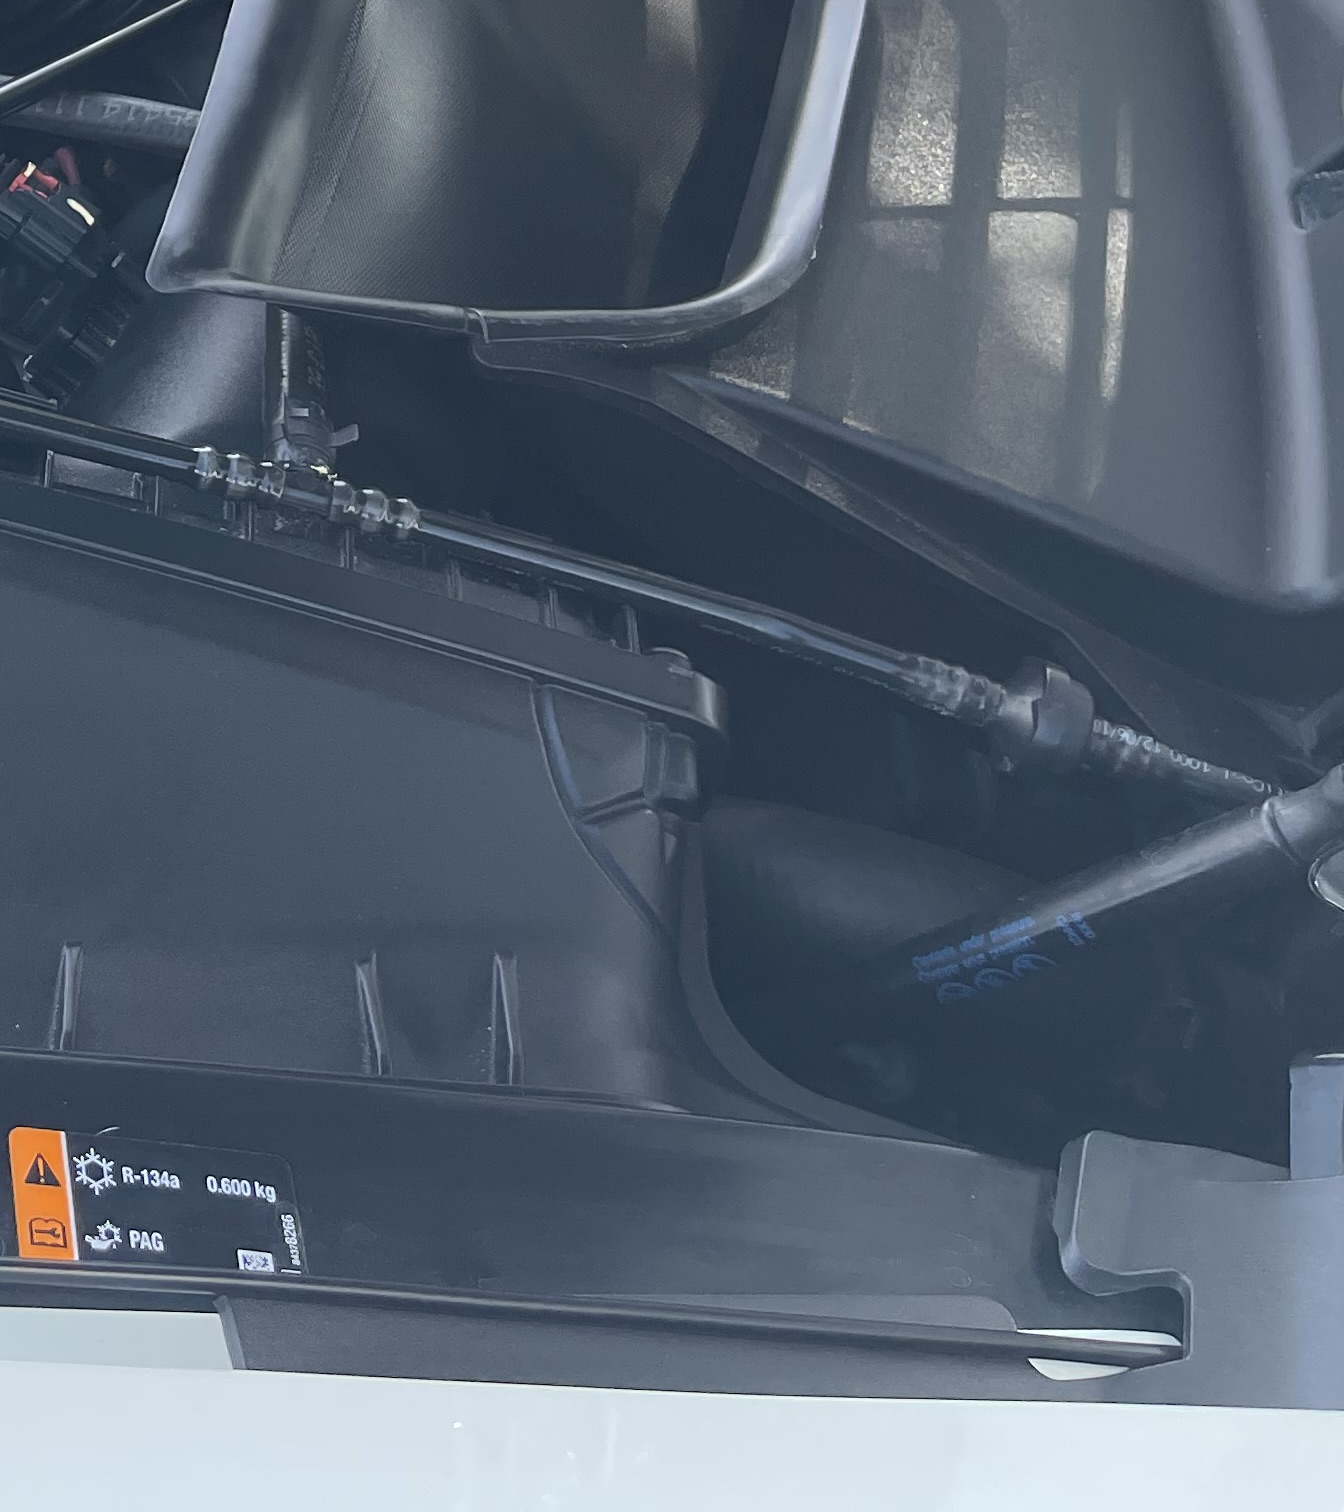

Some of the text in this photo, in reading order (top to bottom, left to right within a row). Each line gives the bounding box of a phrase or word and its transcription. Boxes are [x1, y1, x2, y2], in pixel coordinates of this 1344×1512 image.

[121, 1166, 277, 1203] R-134a 0.600 kg
[128, 1229, 165, 1252] PAG
